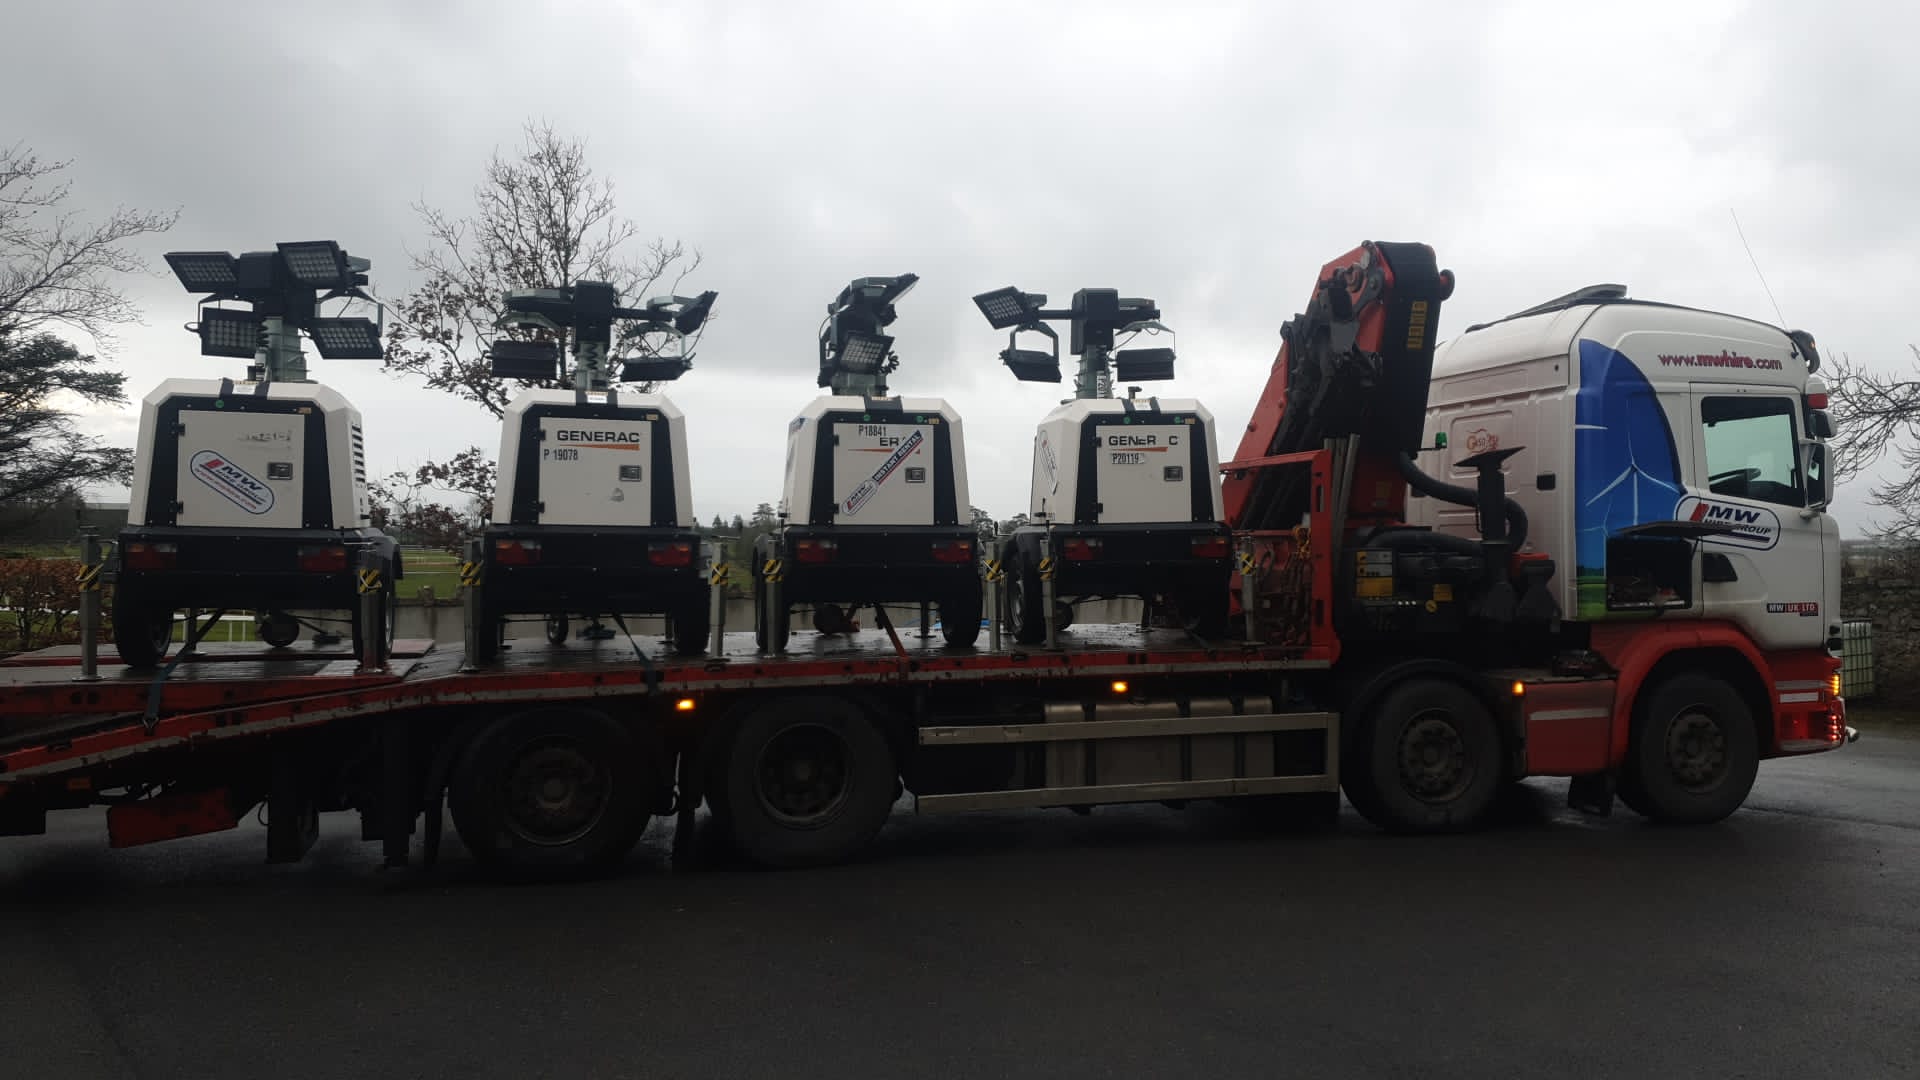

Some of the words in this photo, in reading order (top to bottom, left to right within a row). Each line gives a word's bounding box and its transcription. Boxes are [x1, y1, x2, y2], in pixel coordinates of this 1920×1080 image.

[1657, 350, 1783, 370] www.mwhire.com
[557, 430, 640, 442] GENERAC
[1109, 435, 1179, 446] GENERC
[553, 449, 578, 461] 19078
[222, 465, 263, 490] MW
[1707, 505, 1760, 523] MW
